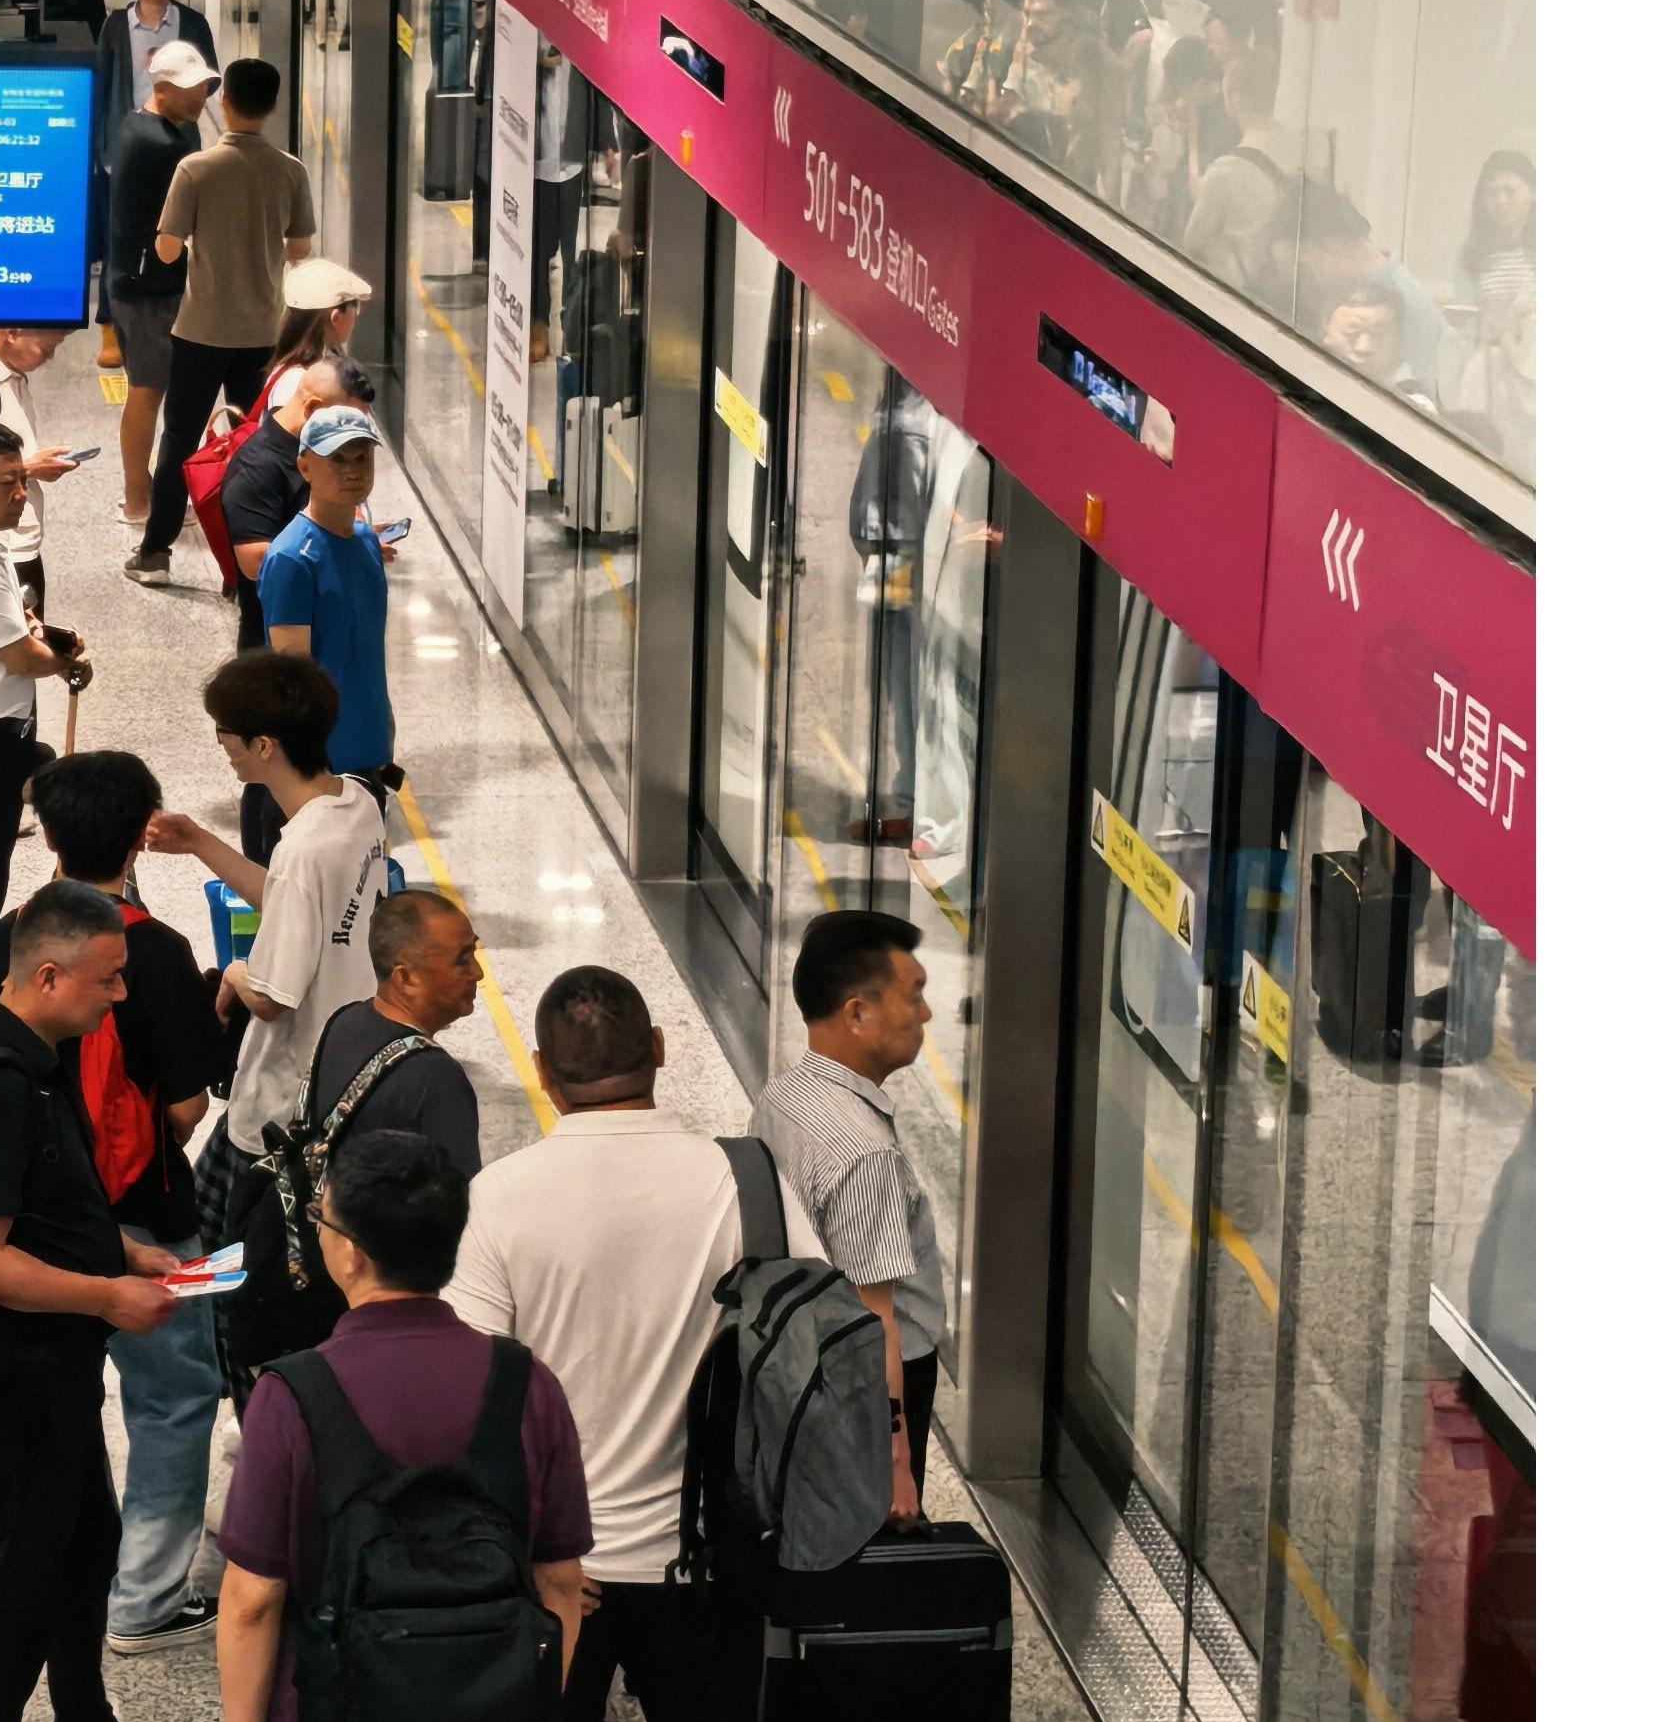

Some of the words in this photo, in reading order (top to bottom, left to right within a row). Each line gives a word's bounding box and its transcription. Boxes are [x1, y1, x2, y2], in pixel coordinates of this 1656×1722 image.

[804, 140, 885, 280] 501-583
[1425, 671, 1528, 830] 卫星厅
